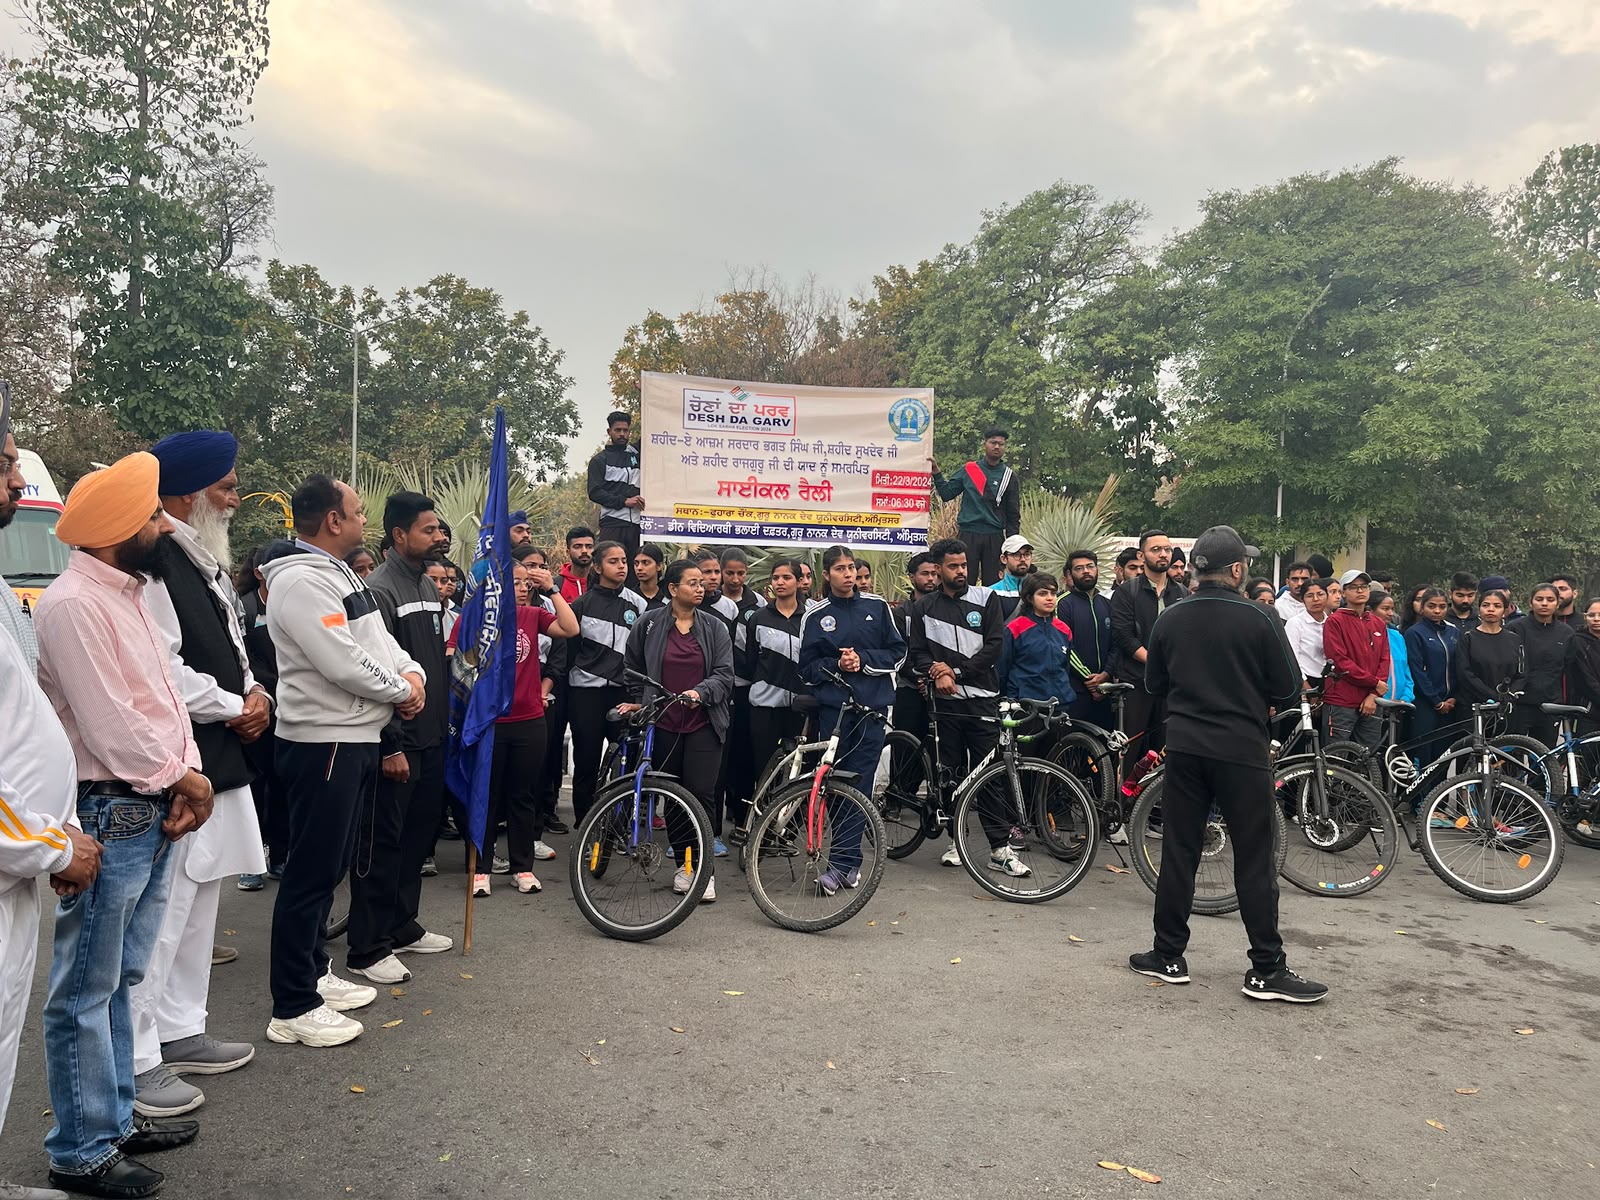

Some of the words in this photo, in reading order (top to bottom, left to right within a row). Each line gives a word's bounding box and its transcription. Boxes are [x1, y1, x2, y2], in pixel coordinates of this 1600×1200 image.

[689, 395, 721, 412] ਚੋਣਾਂ
[728, 402, 747, 414] ਦਾ
[753, 404, 790, 418] ਪਰਵ
[687, 413, 725, 423] DESH
[730, 415, 748, 425] DA
[752, 417, 791, 427] GARV
[728, 439, 759, 451] ਸਰਦਾਰ
[763, 440, 786, 453] ਭਗਤ
[790, 438, 809, 453] ਸਿੰਘ
[856, 443, 883, 459] ਸੁਖਦੇਵ
[887, 443, 898, 458] ਜੀ
[681, 451, 699, 466] ਅਤੇ
[703, 453, 728, 468] ਸ਼ਹੀਦ
[732, 457, 764, 474] ਰਾਜਗੁਰੂ
[769, 456, 780, 471] ਜੀ
[783, 457, 794, 471] ਦੀ
[798, 461, 816, 472] ਯਾਦ
[820, 458, 828, 477] ਨੂੰ
[832, 460, 869, 475] ਸਮਰਪਿਤ
[717, 475, 791, 500] ਸਾਈਕਲ
[798, 477, 833, 502] ਰੈਲੀ
[916, 497, 926, 509] ਵਜੇ
[800, 512, 812, 520] ਦੇਵ
[667, 519, 684, 532] ਡੀਨ
[687, 520, 732, 534] ਵਿਦਿਆਰਥੀ
[735, 522, 760, 535] ਭਲਾਈ
[806, 528, 829, 539] ਨਾਨਕ
[831, 526, 843, 539] ਦੇਵ
[951, 747, 996, 801] MERIDA
[1406, 748, 1451, 794] ROCKRER
